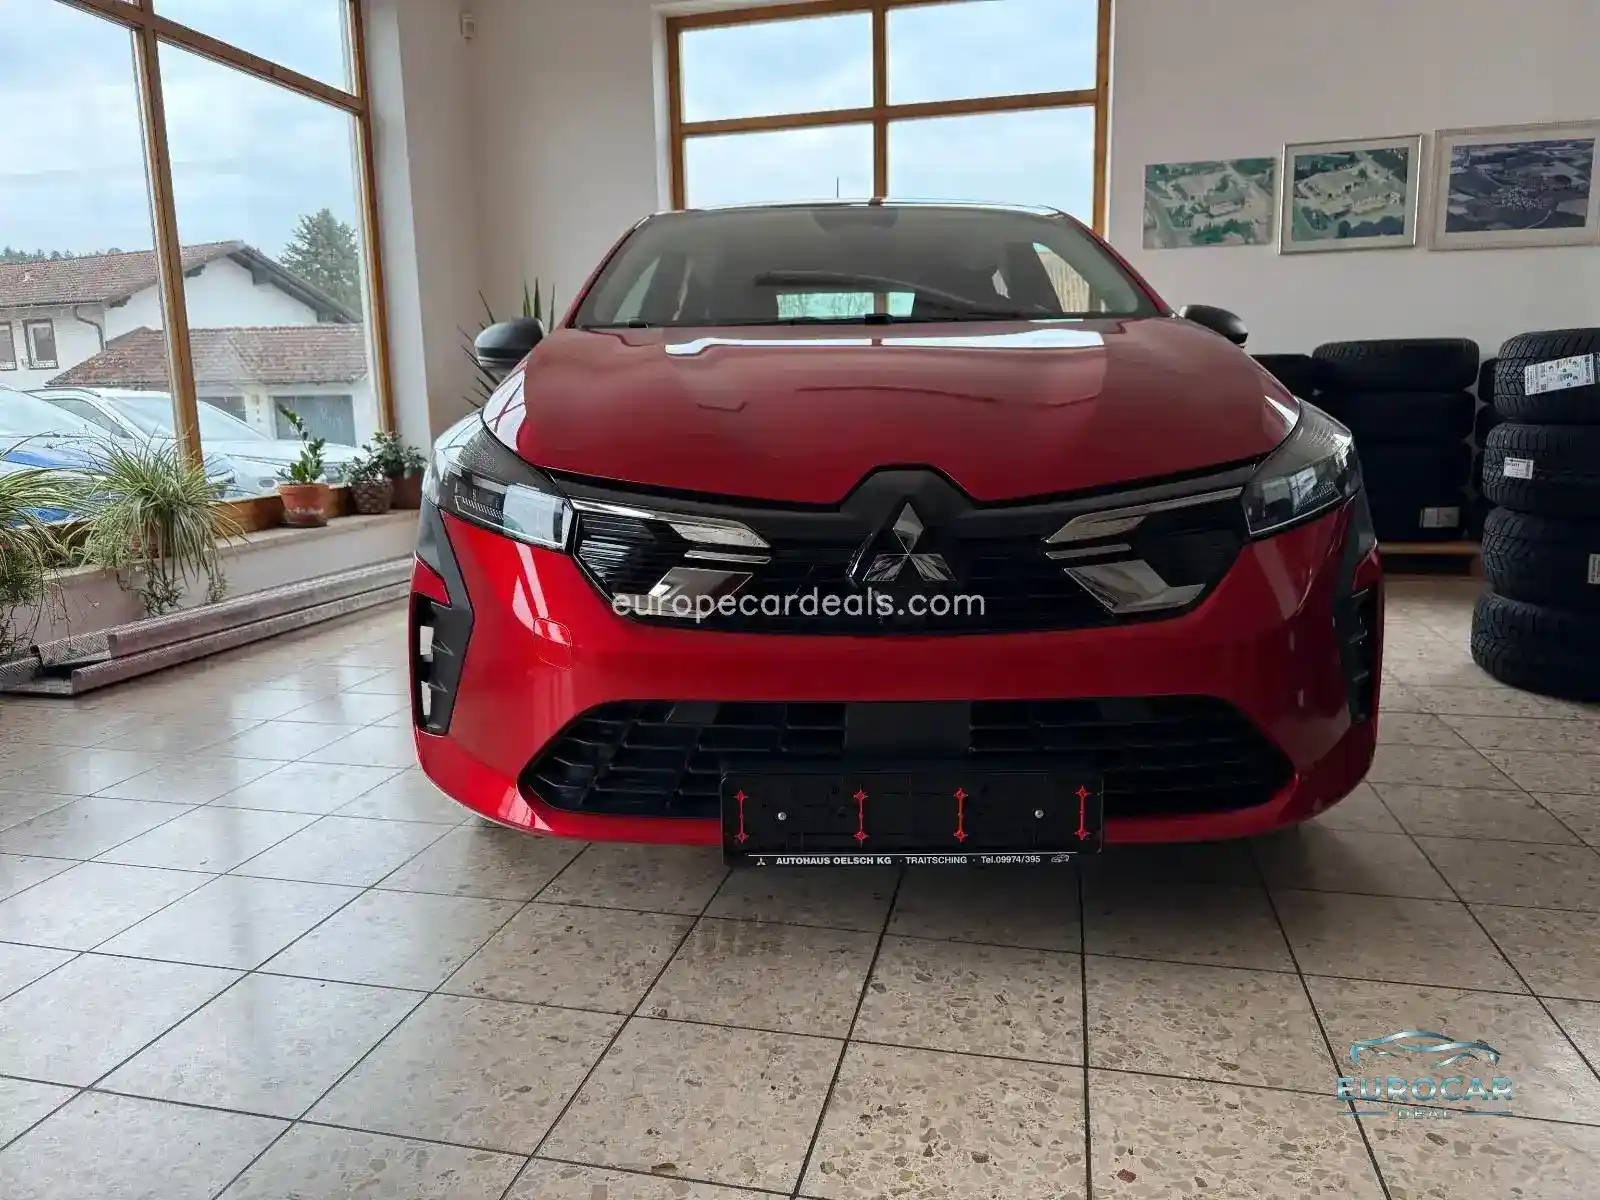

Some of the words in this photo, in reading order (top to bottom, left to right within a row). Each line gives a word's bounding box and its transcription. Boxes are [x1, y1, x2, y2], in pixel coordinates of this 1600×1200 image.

[776, 856, 831, 865] AUTOHAUS
[833, 856, 874, 865] OELSCH
[877, 856, 892, 865] KG
[905, 856, 968, 864] TRAITSCHING
[980, 855, 1041, 864] Tel.09974/395
